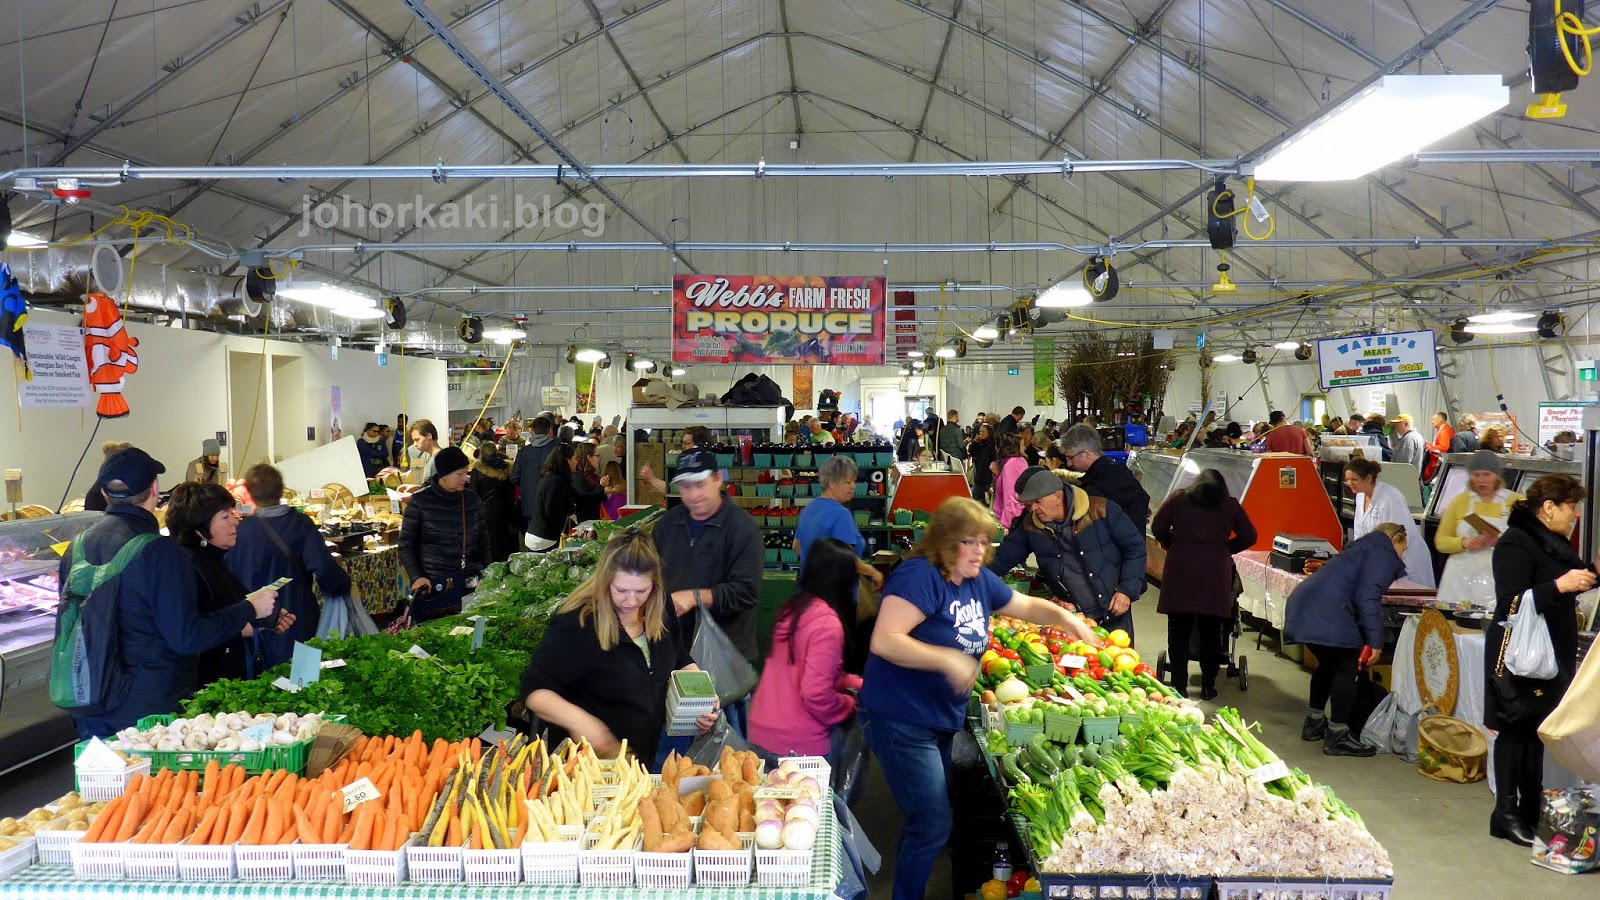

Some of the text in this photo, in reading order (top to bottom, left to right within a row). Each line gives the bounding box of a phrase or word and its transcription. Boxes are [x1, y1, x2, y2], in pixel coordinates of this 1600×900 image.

[685, 277, 871, 309] Webb's FARM FRESH
[686, 311, 874, 334] PRODUCE
[1337, 336, 1416, 354] WAYNE'S
[1363, 348, 1391, 357] MEATS
[34, 361, 55, 370] Georgian
[1334, 363, 1424, 378] PORK LAMB GOAT
